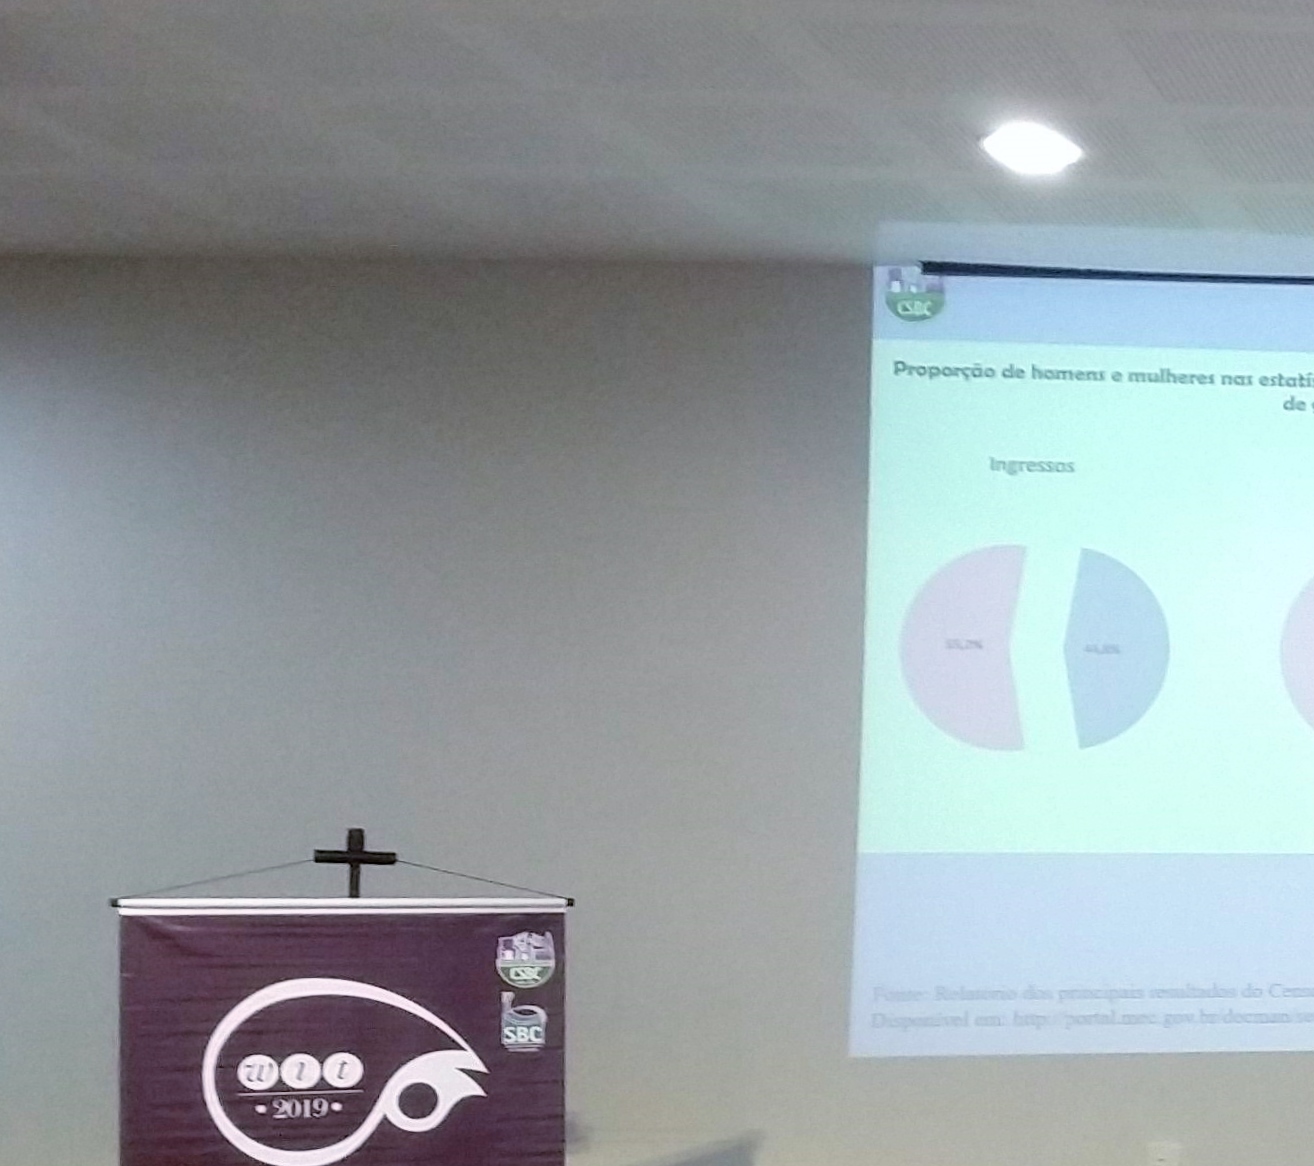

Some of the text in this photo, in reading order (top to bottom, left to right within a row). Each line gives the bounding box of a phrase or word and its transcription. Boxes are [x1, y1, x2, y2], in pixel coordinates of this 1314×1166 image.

[893, 360, 996, 382] Proporção
[1001, 363, 1025, 380] de
[1031, 364, 1105, 382] homens
[1111, 370, 1122, 383] e
[1128, 367, 1215, 386] mulheres
[1221, 374, 1253, 387] nas
[1283, 395, 1307, 412] de
[989, 455, 1075, 475] Ingressos
[504, 1026, 543, 1043] SBC
[272, 1098, 329, 1118] 2019
